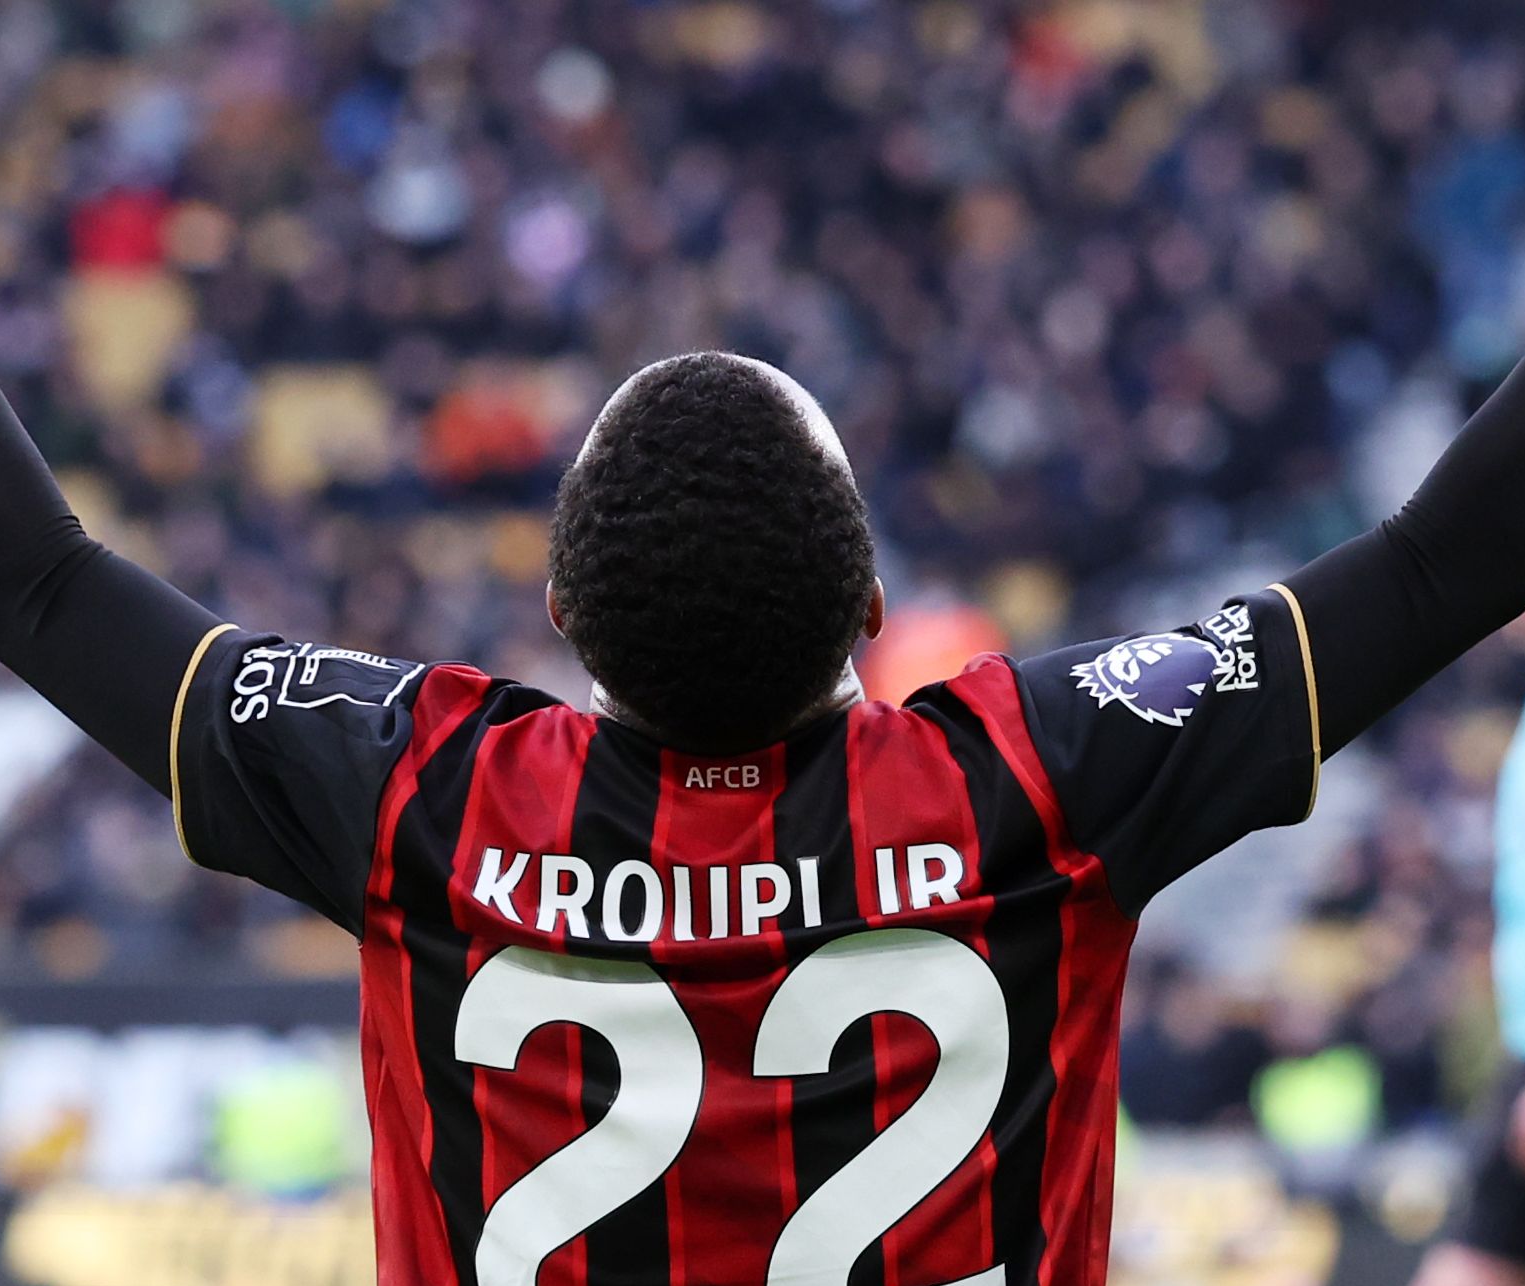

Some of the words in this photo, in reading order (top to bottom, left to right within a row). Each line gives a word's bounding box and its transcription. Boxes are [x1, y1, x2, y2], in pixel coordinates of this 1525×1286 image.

[1212, 648, 1236, 692] No
[685, 765, 760, 789] AFCB
[472, 847, 822, 942] KROUPI
